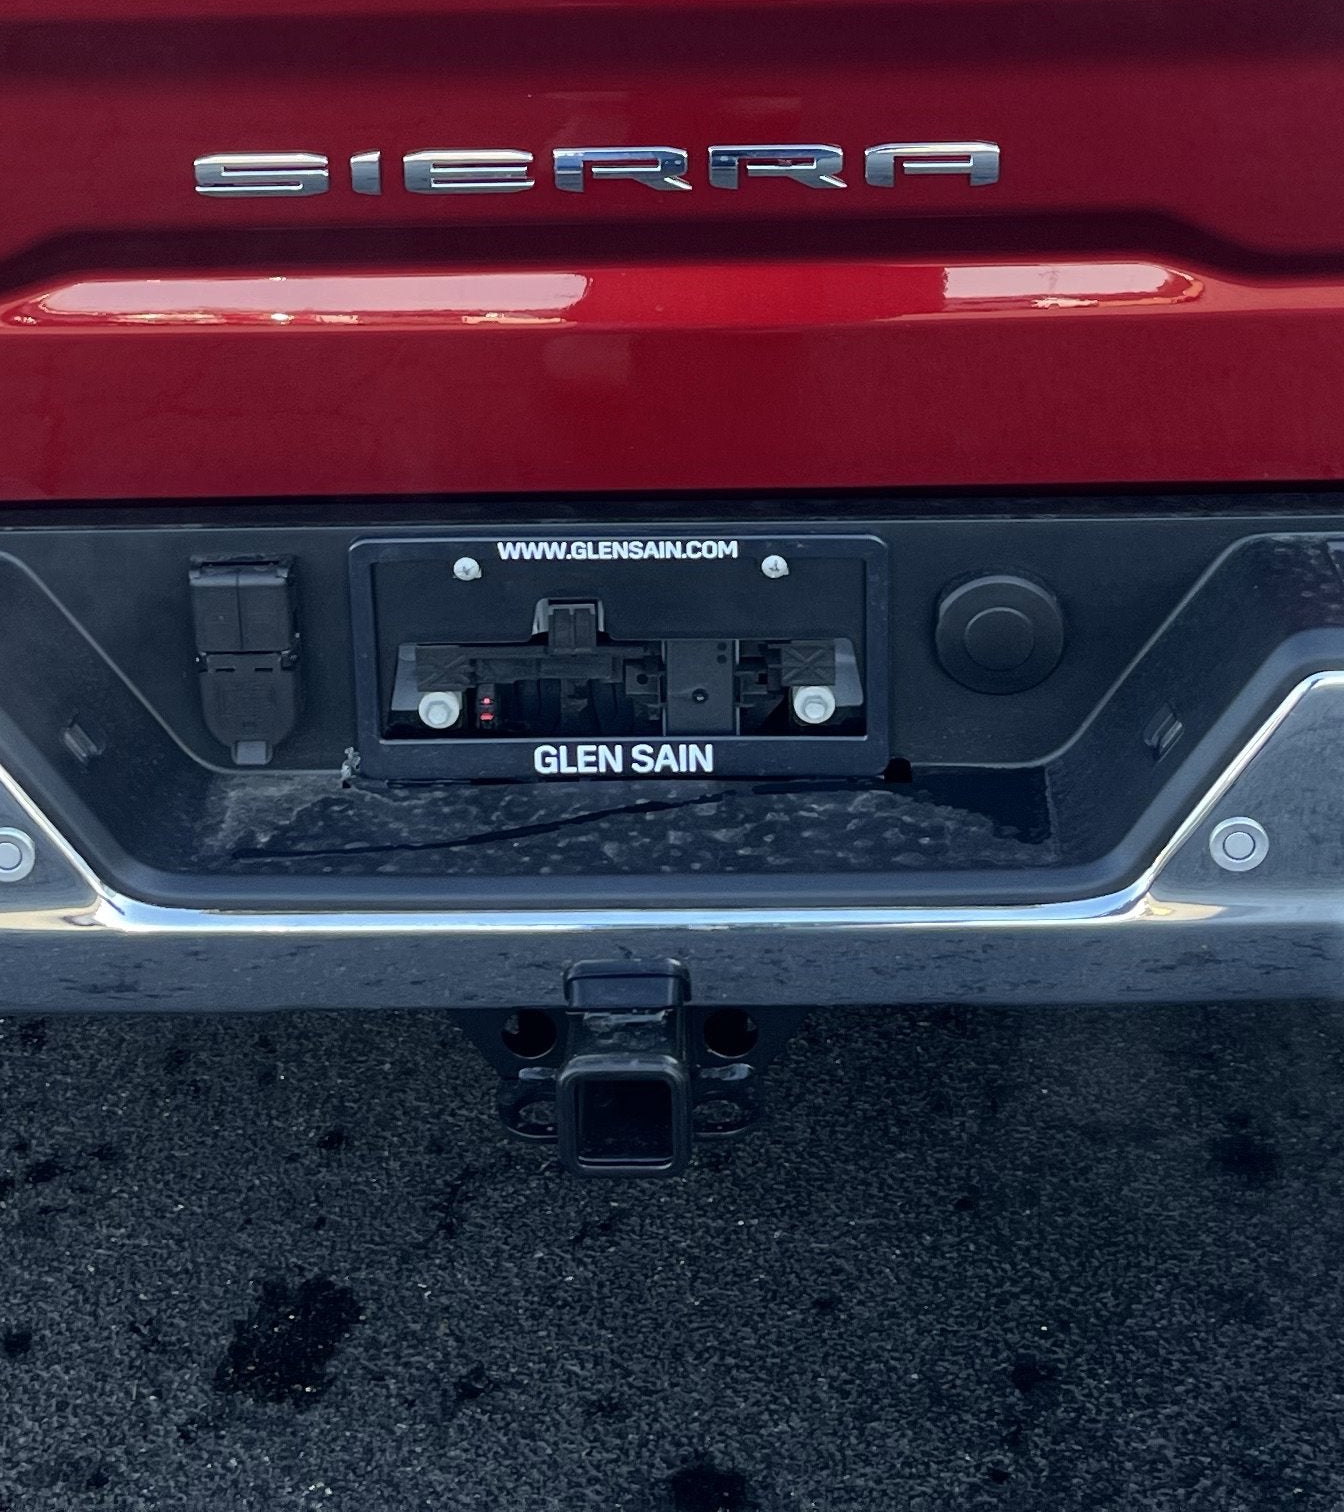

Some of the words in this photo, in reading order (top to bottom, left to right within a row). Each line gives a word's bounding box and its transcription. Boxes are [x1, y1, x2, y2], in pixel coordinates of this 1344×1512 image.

[193, 140, 1001, 198] SIERRA
[497, 540, 739, 561] WWW.GLENSAIN.COM
[533, 744, 624, 775] GLEN
[631, 743, 715, 773] SAIN
